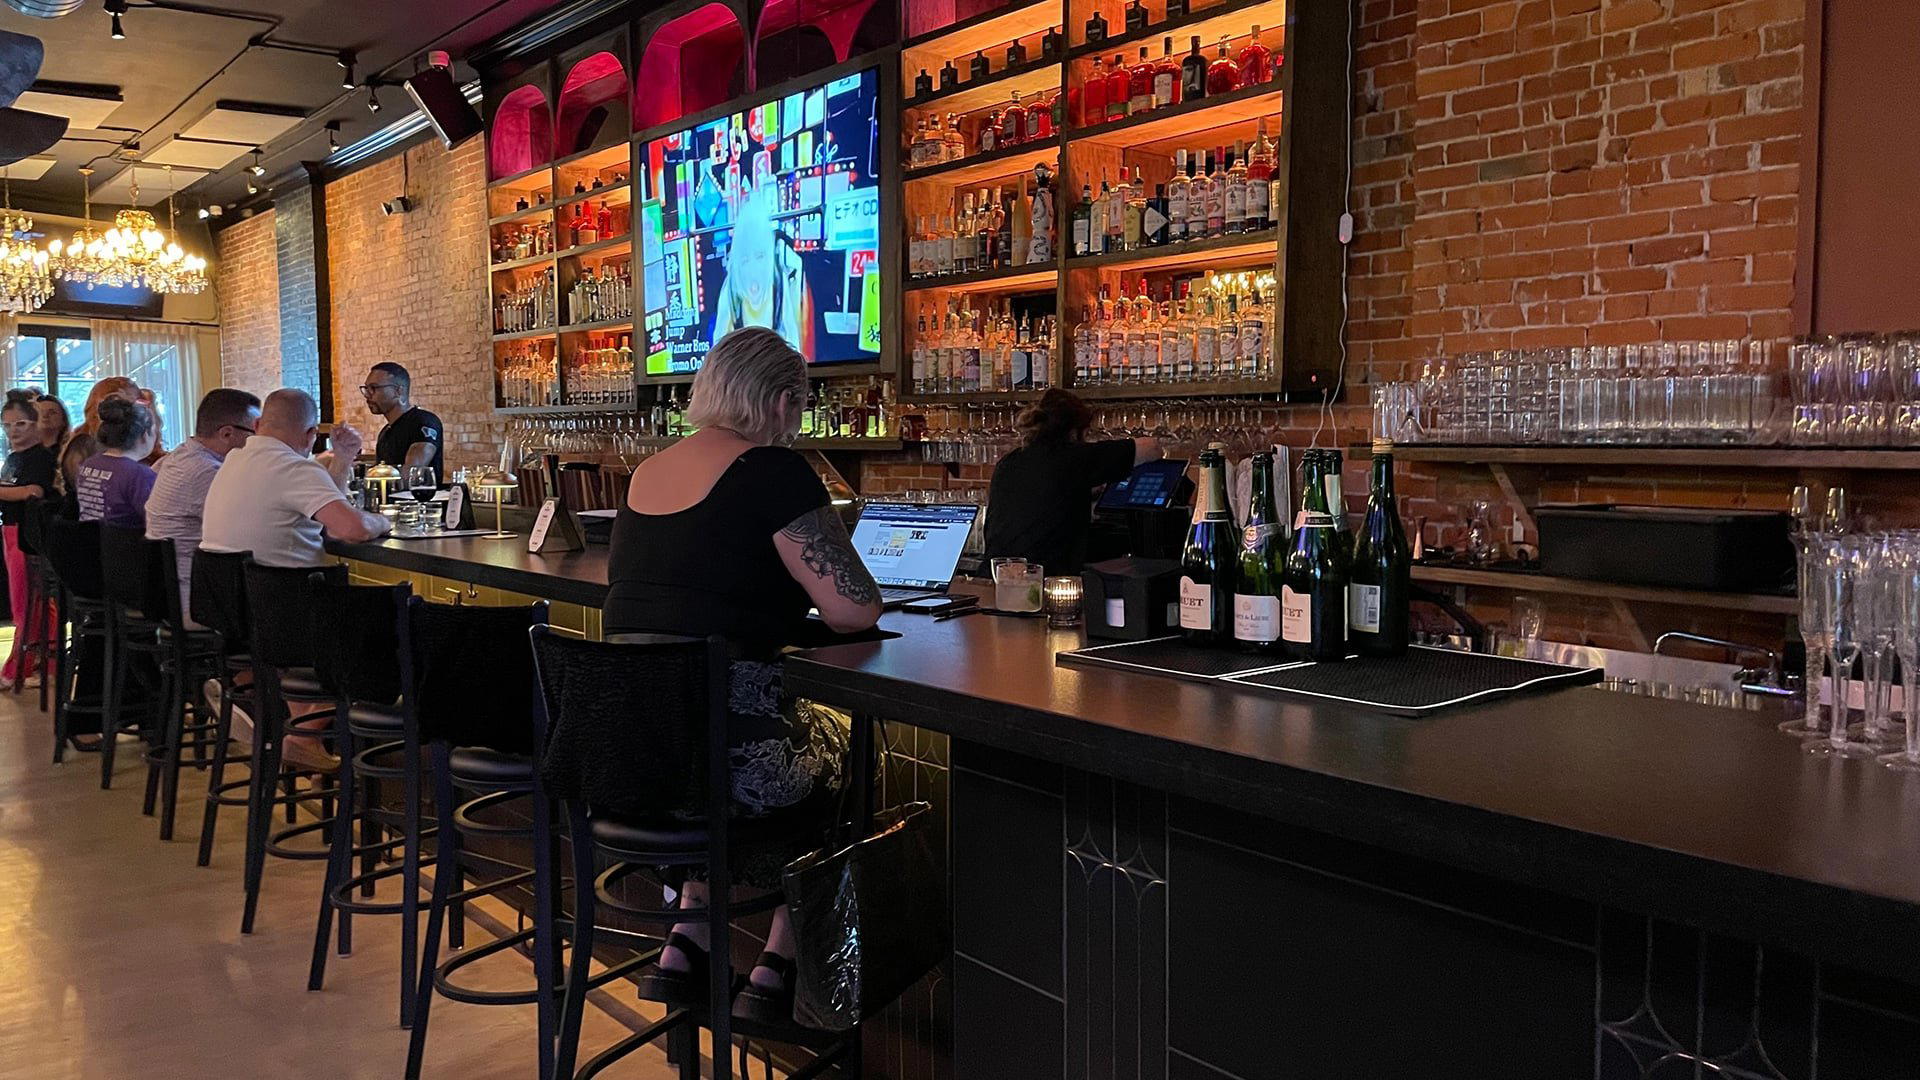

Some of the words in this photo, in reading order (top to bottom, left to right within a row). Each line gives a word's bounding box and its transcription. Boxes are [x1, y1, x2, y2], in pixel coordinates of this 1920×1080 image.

[863, 199, 878, 216] CD
[665, 325, 686, 340] Jump
[666, 341, 692, 354] Warner
